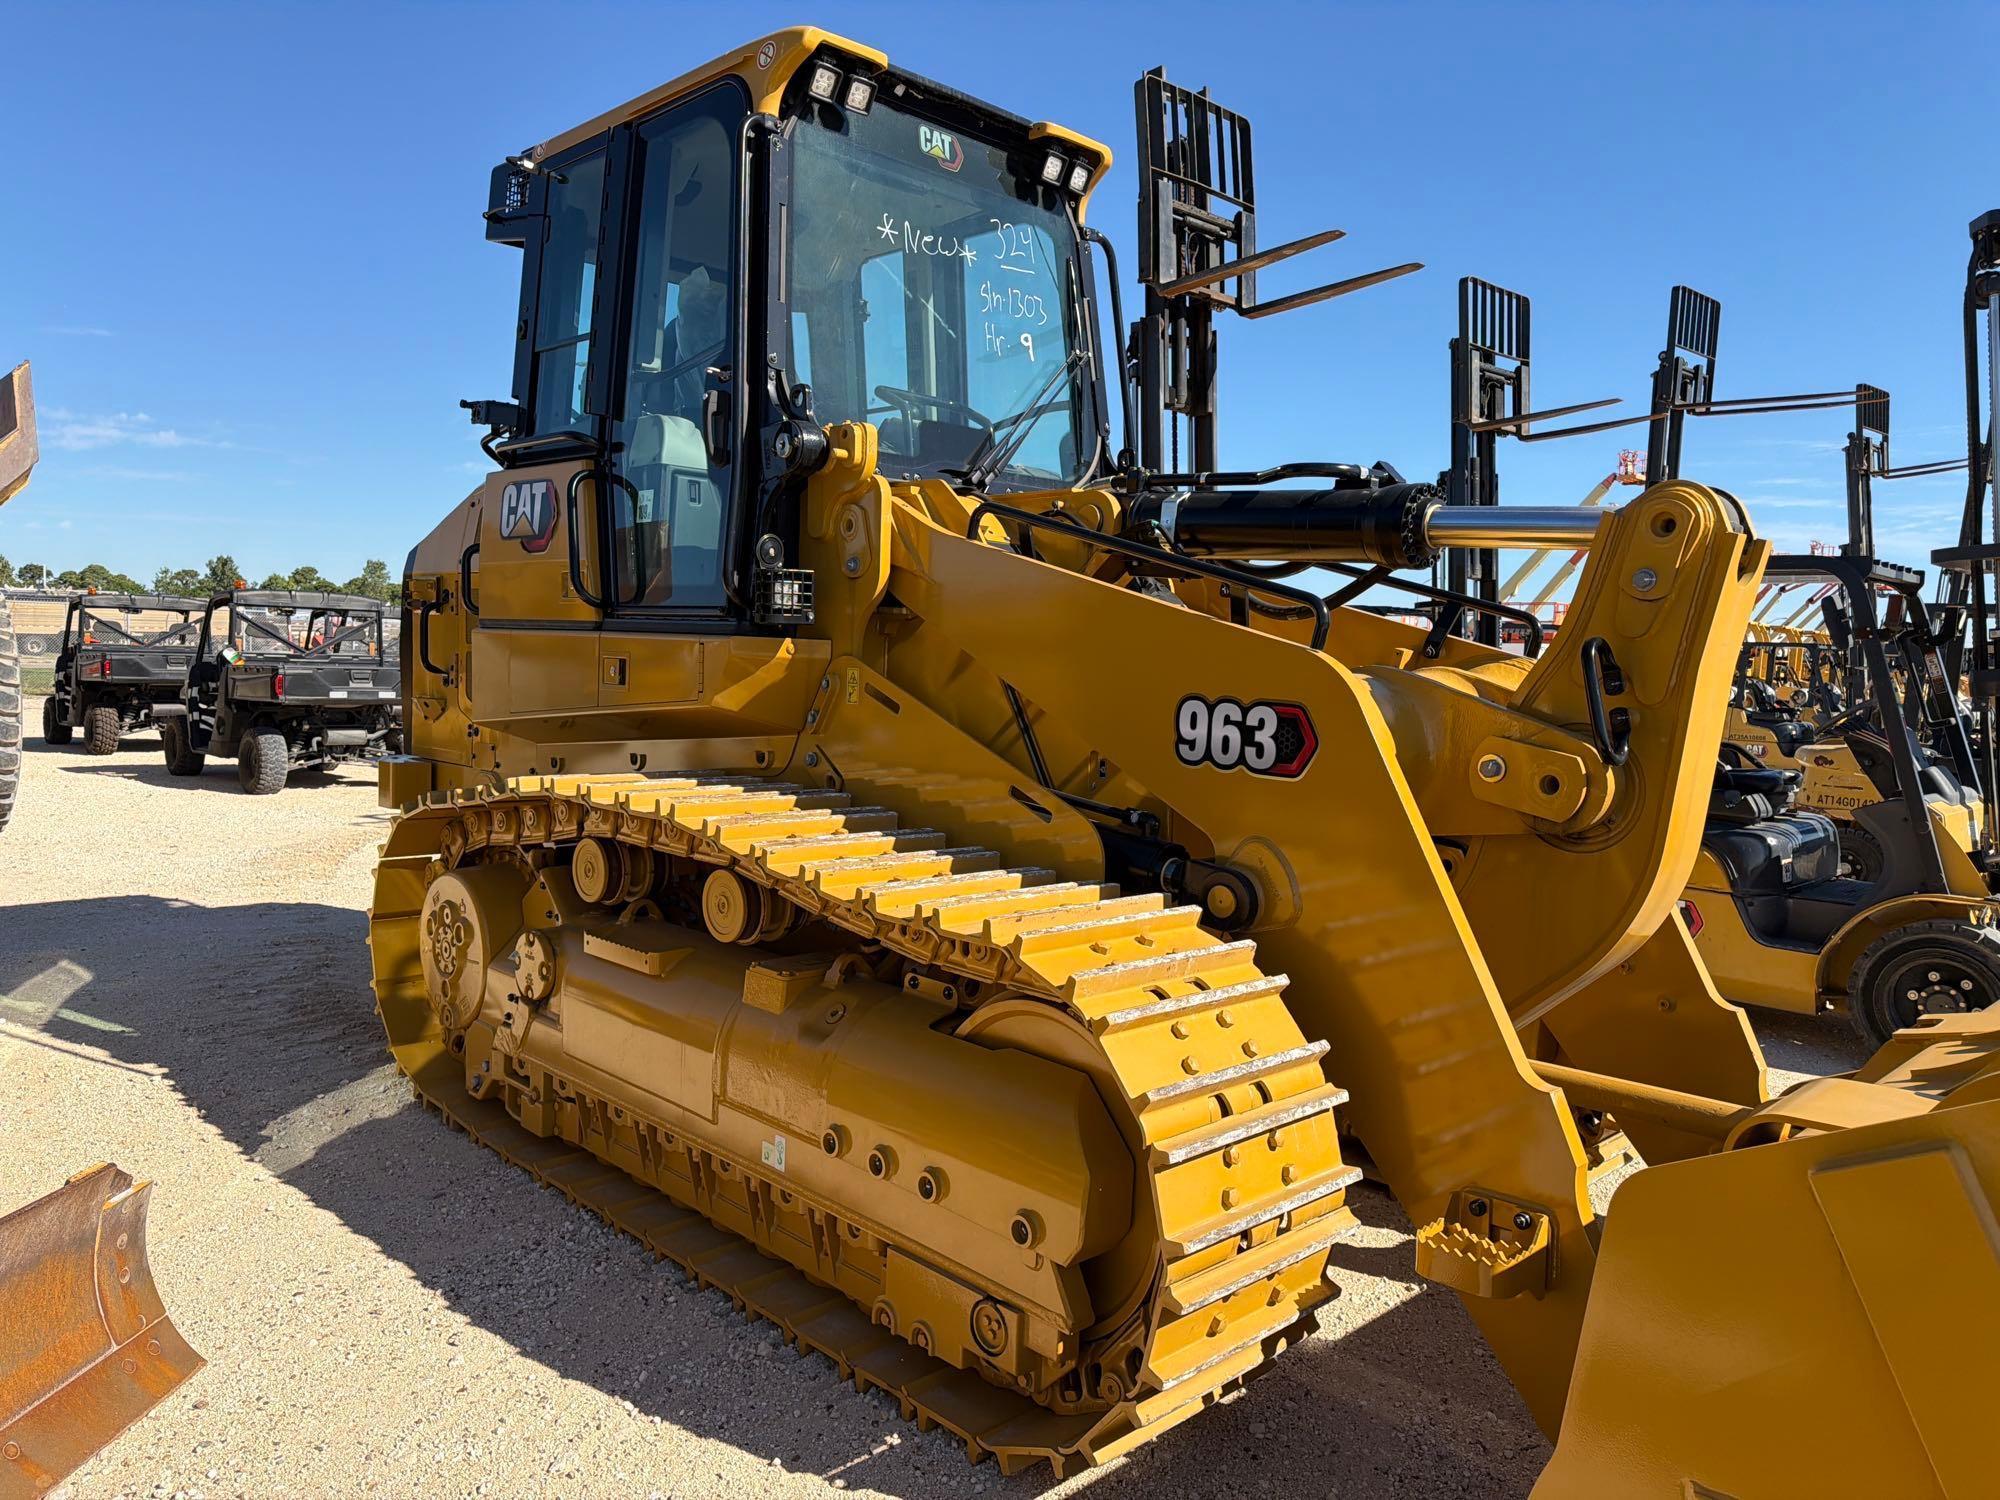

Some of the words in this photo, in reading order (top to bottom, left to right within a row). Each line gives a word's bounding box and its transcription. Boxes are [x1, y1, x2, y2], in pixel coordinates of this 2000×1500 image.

[919, 125, 953, 160] CAT
[990, 218, 1036, 264] 324
[1020, 332, 1035, 362] 9
[501, 481, 548, 538] CAT
[1178, 699, 1279, 770] 963
[1746, 743, 1765, 756] CAT
